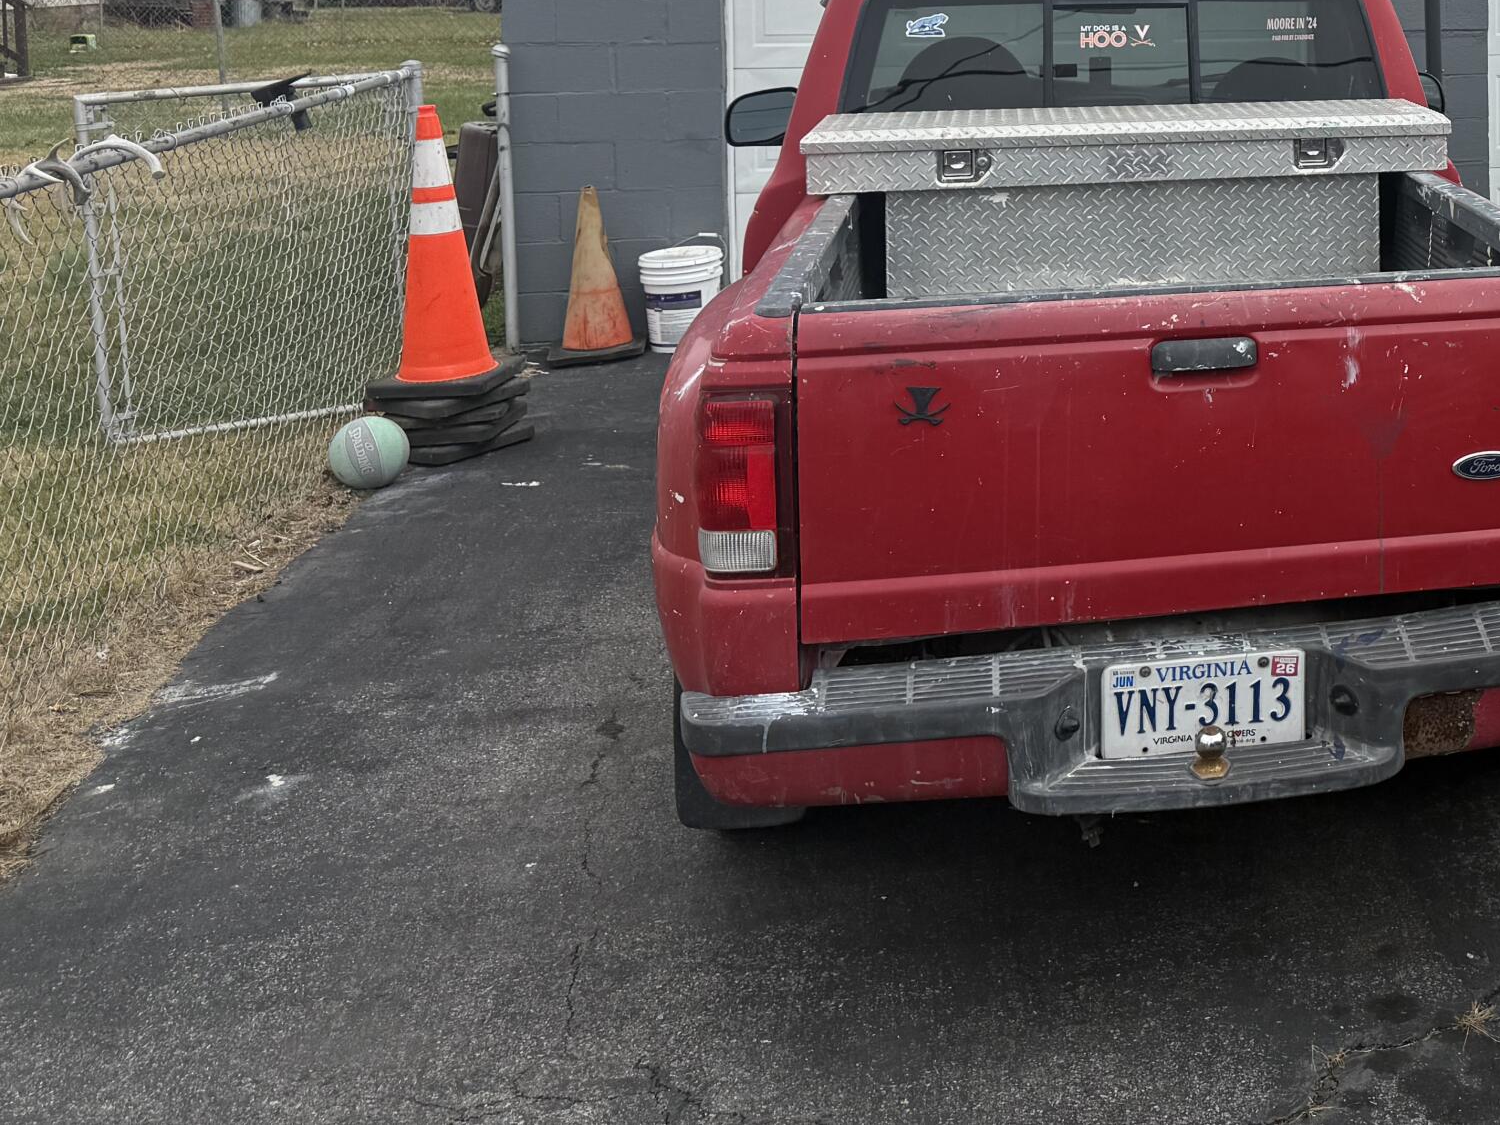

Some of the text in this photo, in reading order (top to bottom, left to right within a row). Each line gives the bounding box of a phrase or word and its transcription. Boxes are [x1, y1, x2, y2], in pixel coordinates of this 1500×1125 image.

[1266, 17, 1295, 30] MOORE
[1296, 17, 1305, 29] IN
[1080, 31, 1127, 48] HOO
[1155, 660, 1253, 683] VIRGINIA
[1275, 663, 1295, 674] 26
[1112, 676, 1134, 688] JUN
[1114, 677, 1292, 736] VNY-3113
[1153, 733, 1193, 745] VIRGINIA
